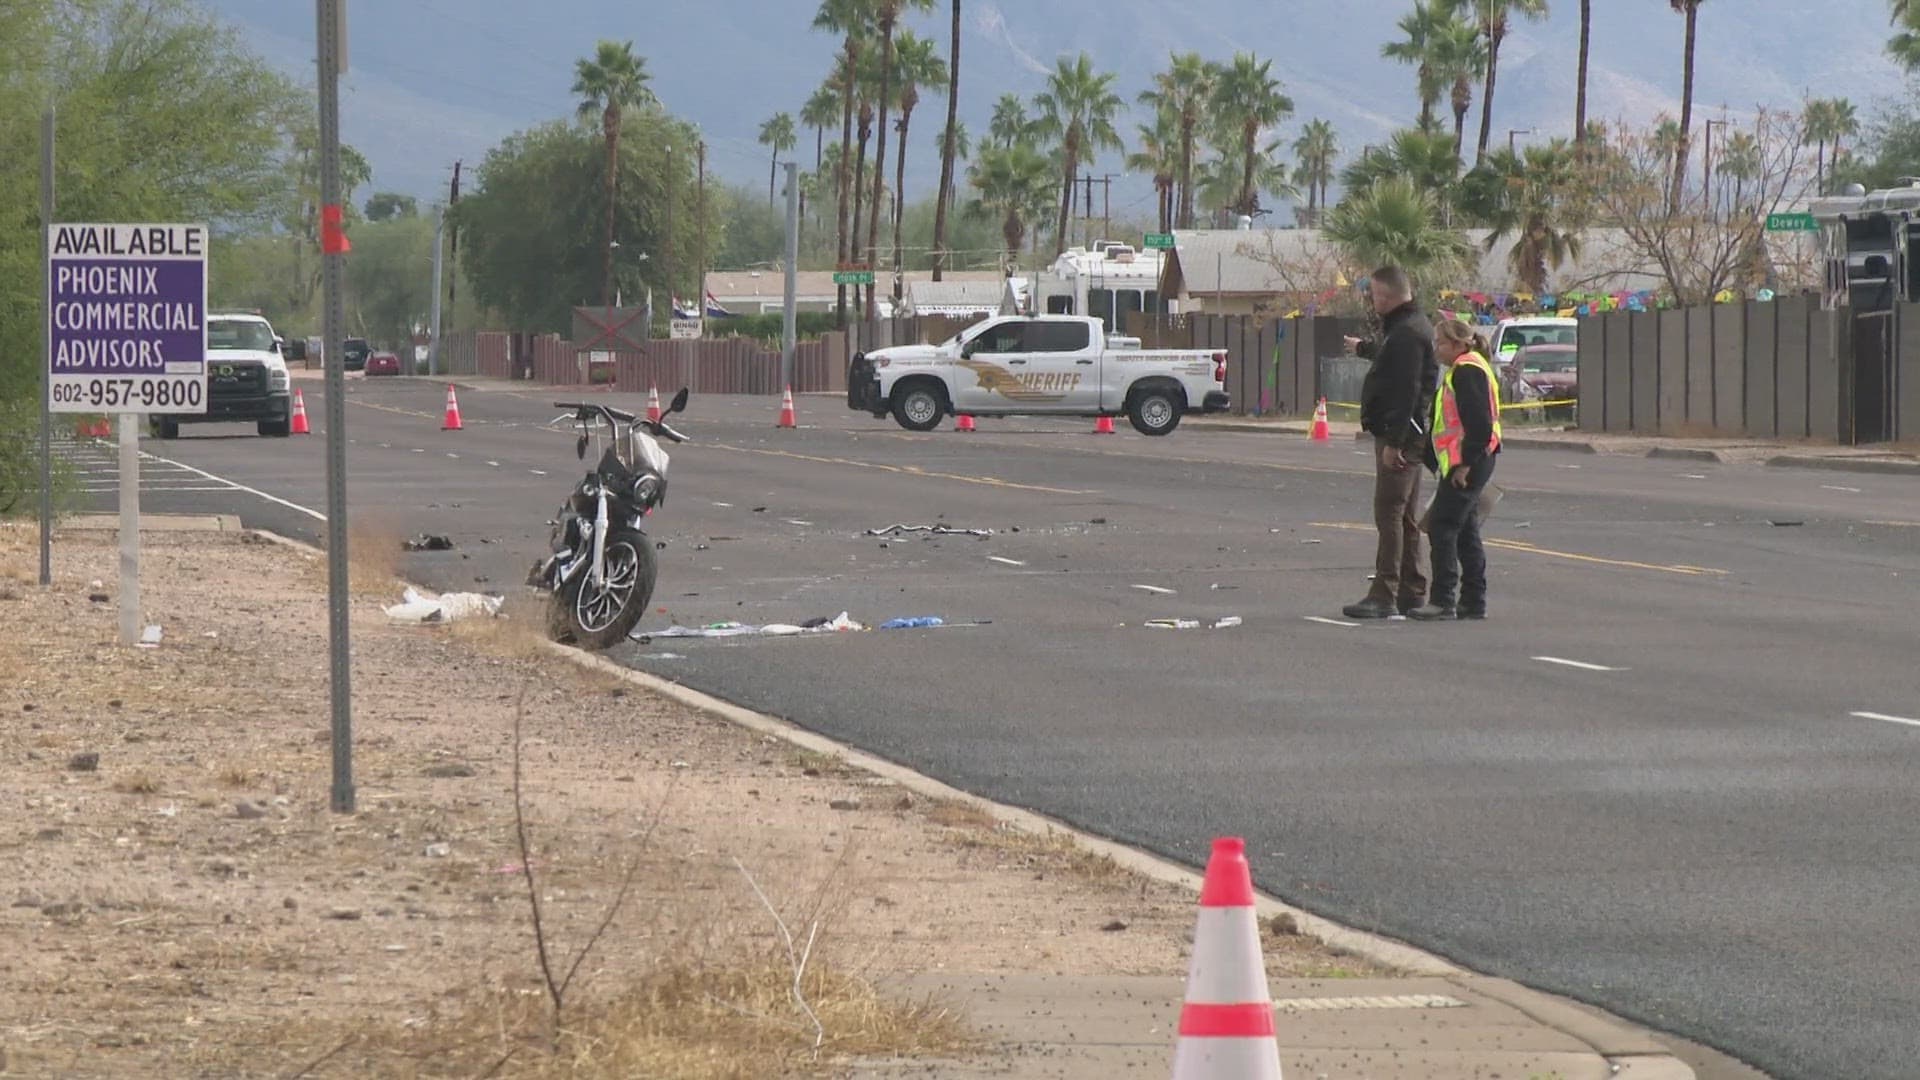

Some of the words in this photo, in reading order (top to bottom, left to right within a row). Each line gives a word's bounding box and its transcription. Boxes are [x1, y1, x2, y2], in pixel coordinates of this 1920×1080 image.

[1771, 216, 1807, 229] Dewey
[53, 227, 201, 255] AVAILABLE
[57, 266, 159, 295] PHOENIX
[54, 302, 200, 331] COMMERCIAL
[55, 338, 164, 368] ADVISORS
[53, 379, 202, 407] 602-957-9800
[1014, 372, 1082, 391] SHERIFF
